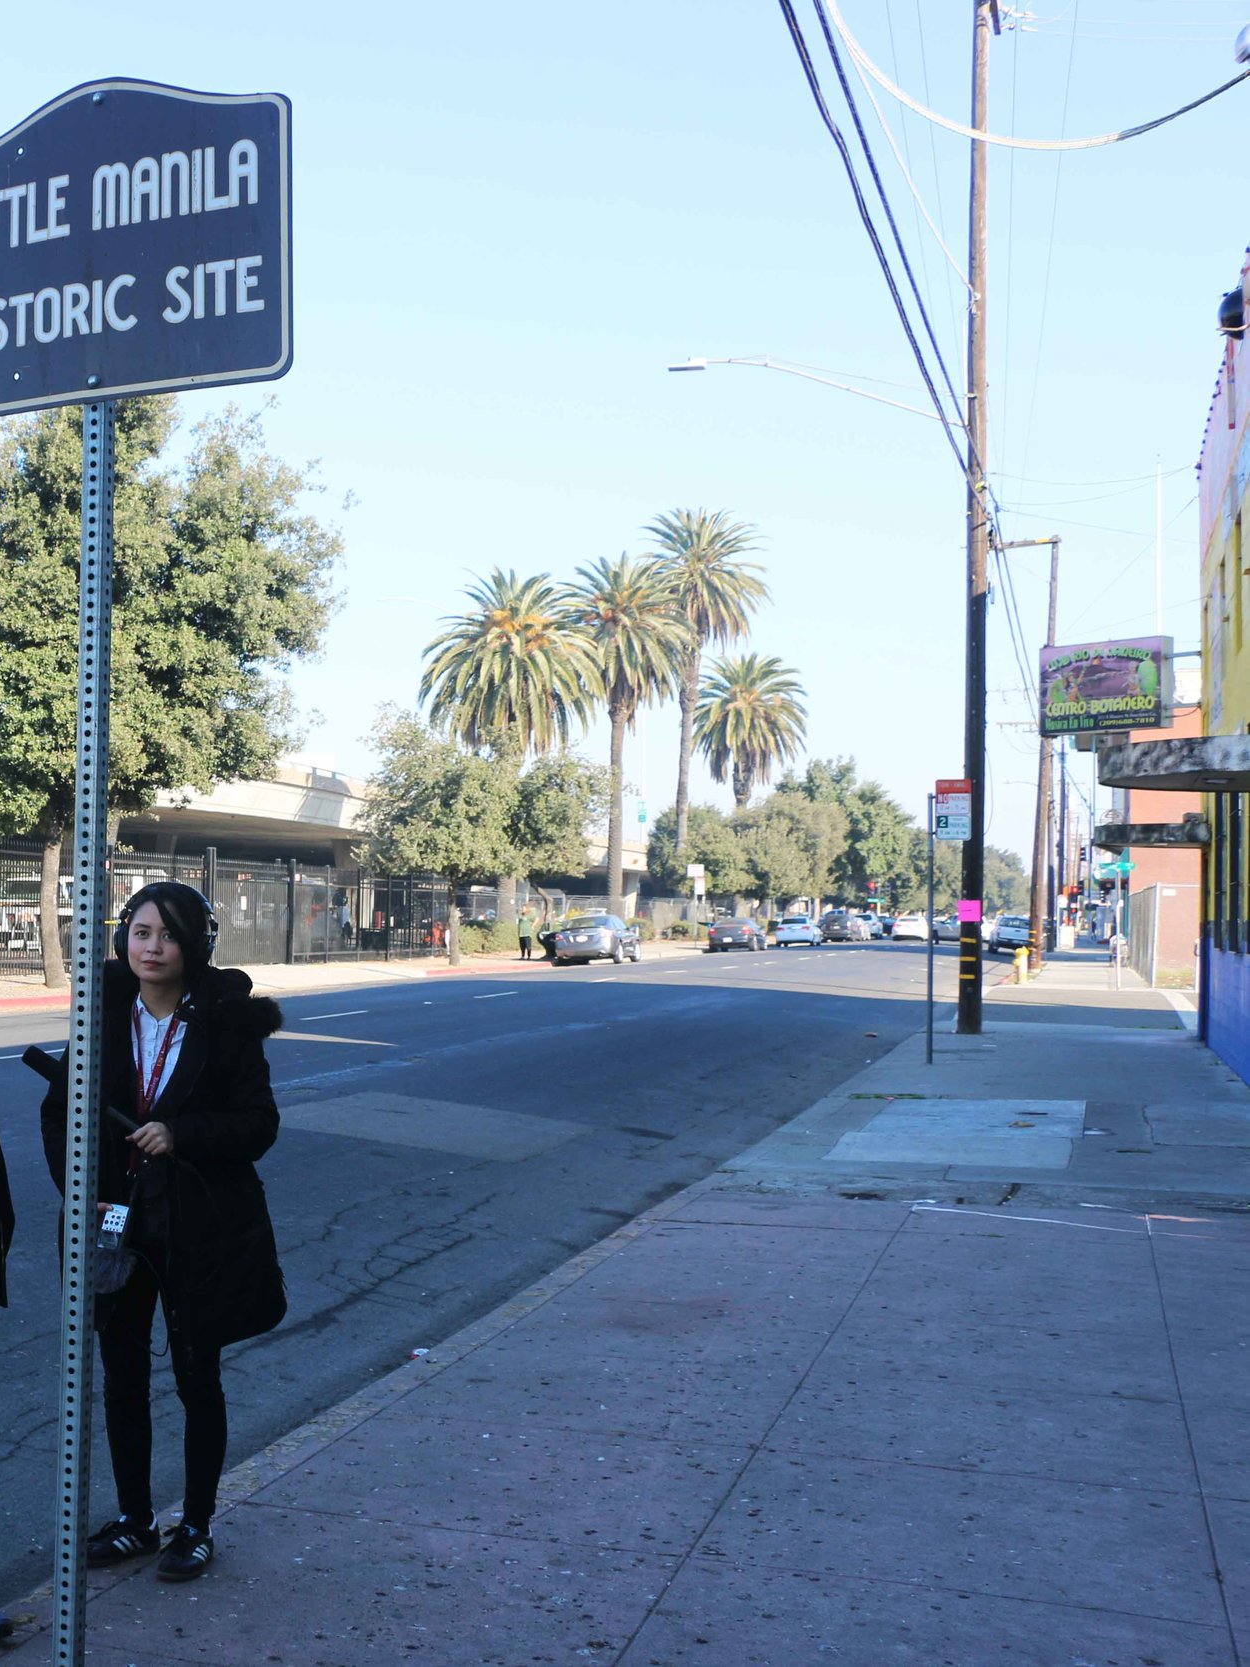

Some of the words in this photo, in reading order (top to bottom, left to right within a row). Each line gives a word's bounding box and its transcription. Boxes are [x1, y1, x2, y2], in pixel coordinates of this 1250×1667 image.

[91, 138, 259, 231] MANILA
[162, 255, 265, 324] SITE
[1046, 701, 1087, 717] CENTRO
[1090, 695, 1156, 715] BOTANERO
[939, 817, 947, 827] 2
